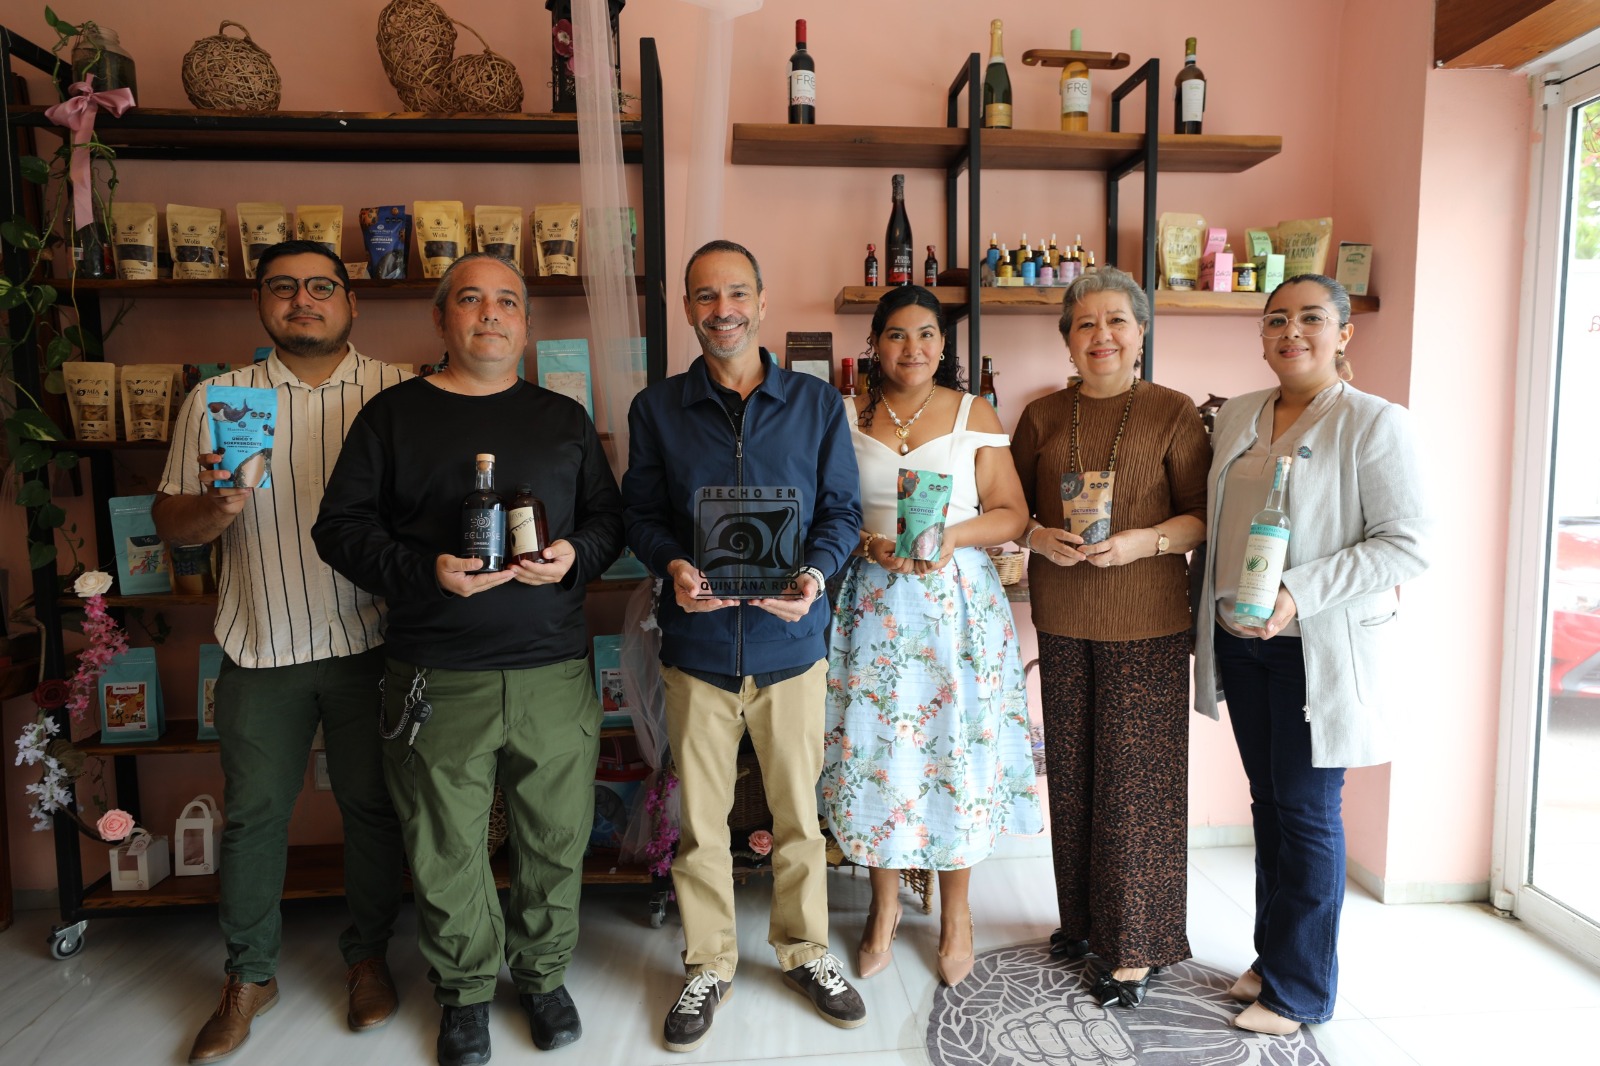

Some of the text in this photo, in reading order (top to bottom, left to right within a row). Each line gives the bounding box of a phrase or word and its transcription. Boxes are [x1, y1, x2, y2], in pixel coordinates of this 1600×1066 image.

[702, 488, 796, 498] HECHO EN
[464, 531, 501, 540] ECLIPSE
[700, 581, 798, 592] QUINTANA ROO
